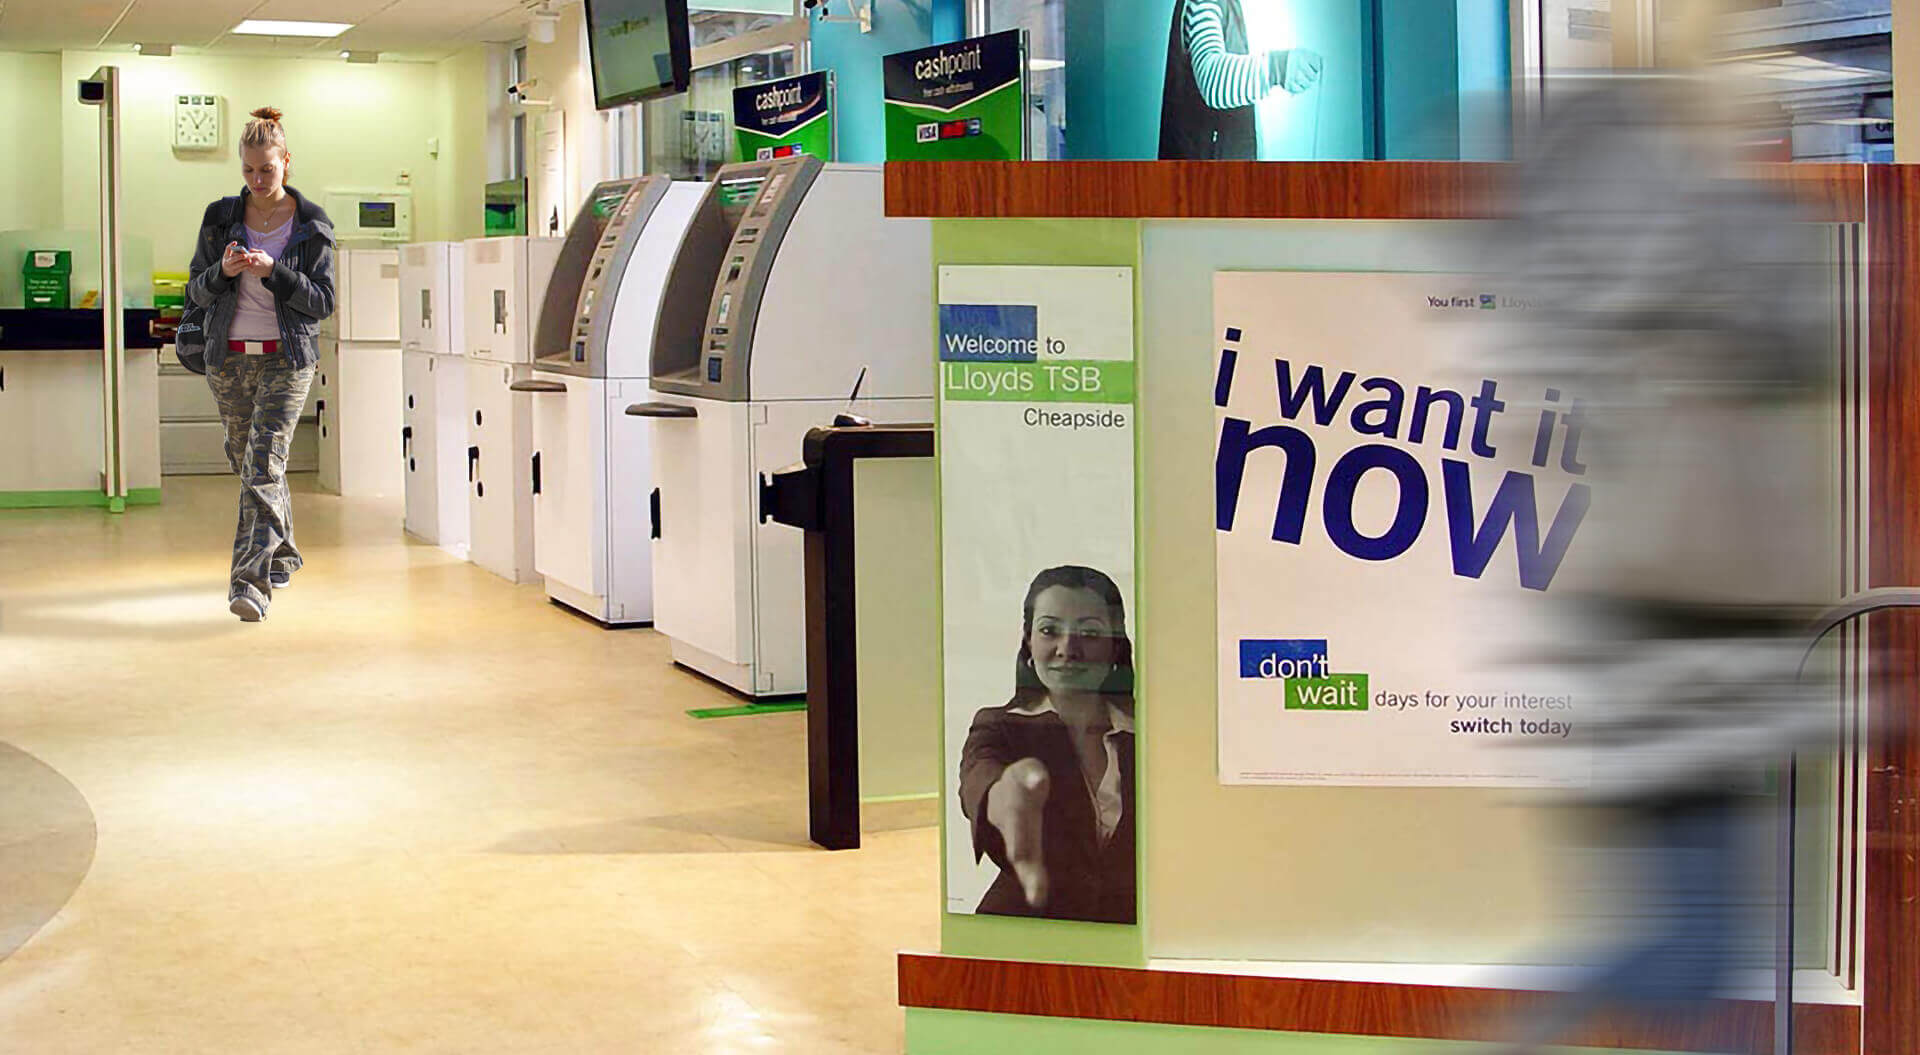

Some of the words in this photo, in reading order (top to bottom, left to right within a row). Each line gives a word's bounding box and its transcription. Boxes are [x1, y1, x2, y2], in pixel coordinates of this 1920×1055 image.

[915, 44, 981, 80] cashpoint
[756, 81, 802, 112] cashpoint
[1427, 296, 1448, 308] You
[1451, 296, 1474, 308] first
[945, 334, 1037, 354] Welcome
[1046, 337, 1065, 354] to
[948, 364, 1034, 396] Lloyds
[1043, 366, 1101, 391] TSB
[1214, 327, 1242, 407] i
[1275, 359, 1505, 459] want
[1531, 388, 1592, 476] it
[1023, 408, 1125, 430] Cheapside
[1216, 416, 1592, 592] now
[1259, 653, 1329, 679] don't
[1297, 681, 1358, 706] wait
[1375, 691, 1419, 709] days
[1425, 690, 1450, 708] for
[1455, 693, 1497, 711] your
[1503, 692, 1573, 711] interest
[1450, 718, 1512, 735] switch
[1519, 719, 1573, 738] today
